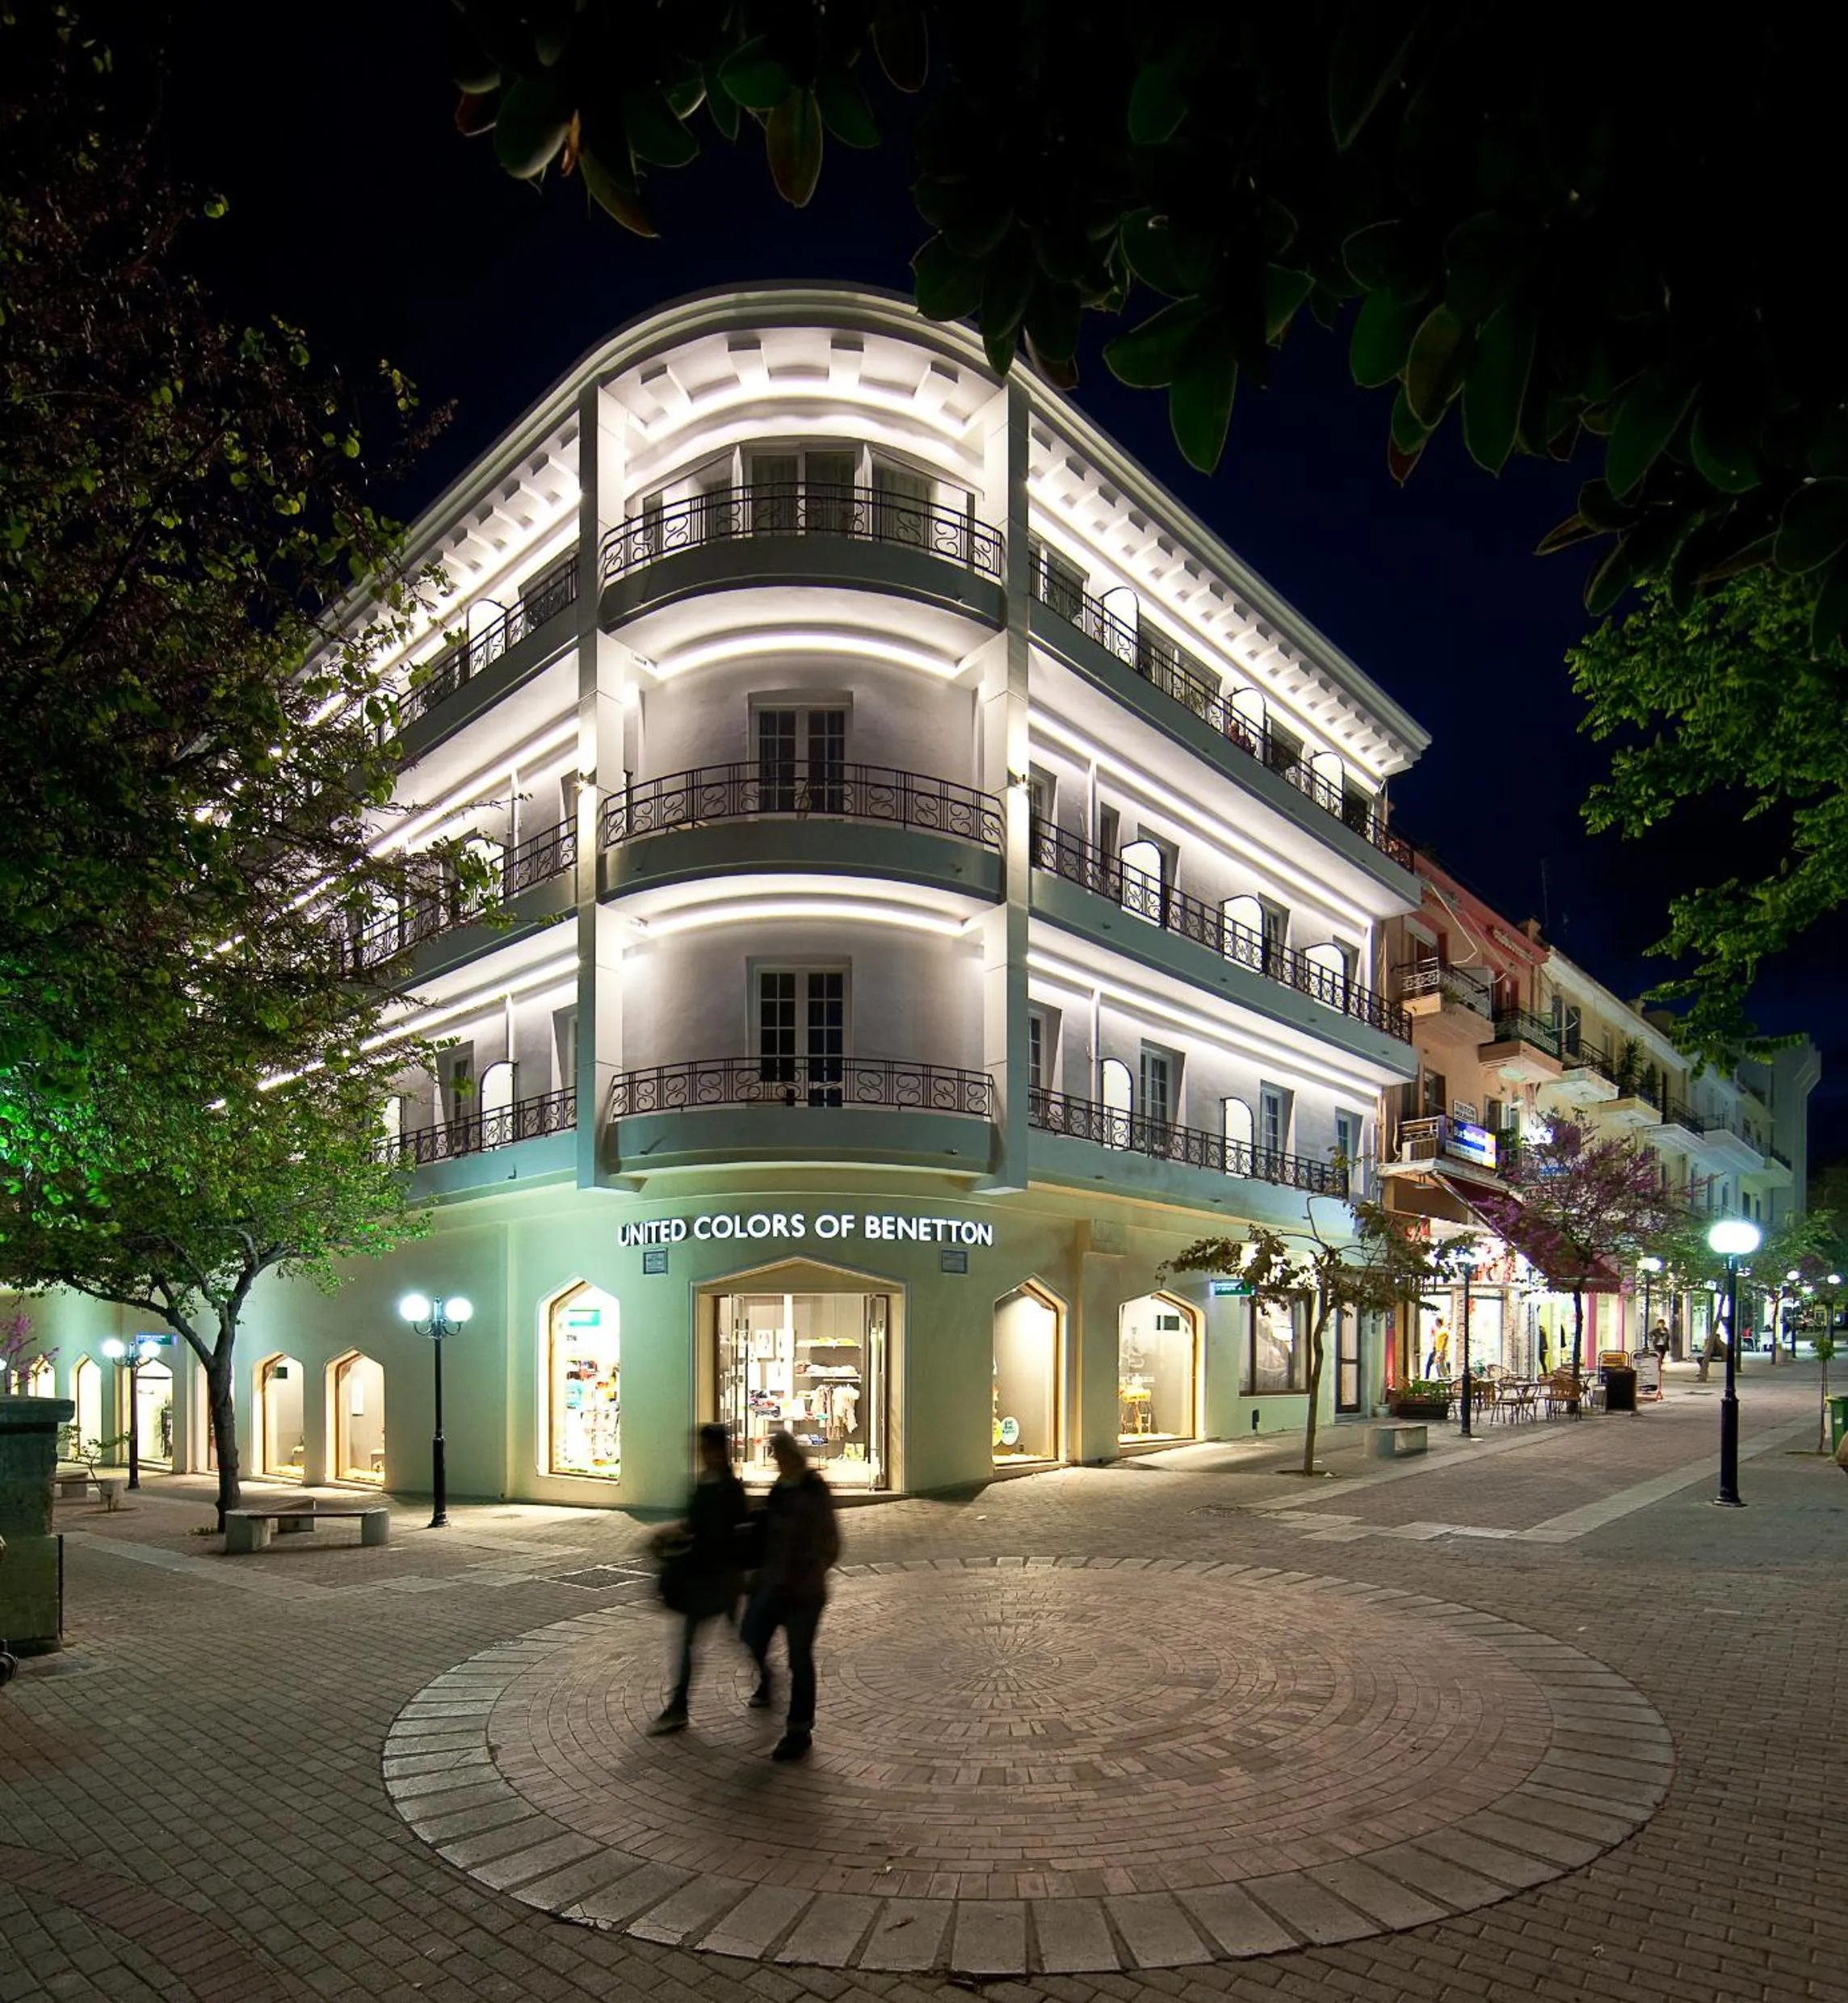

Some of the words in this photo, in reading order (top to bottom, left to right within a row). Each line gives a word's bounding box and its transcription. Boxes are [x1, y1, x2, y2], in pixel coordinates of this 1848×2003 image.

[618, 1218, 687, 1247] UNITED
[693, 1213, 806, 1240] COLORS
[814, 1214, 855, 1239] OF
[864, 1215, 993, 1247] BENETTON
